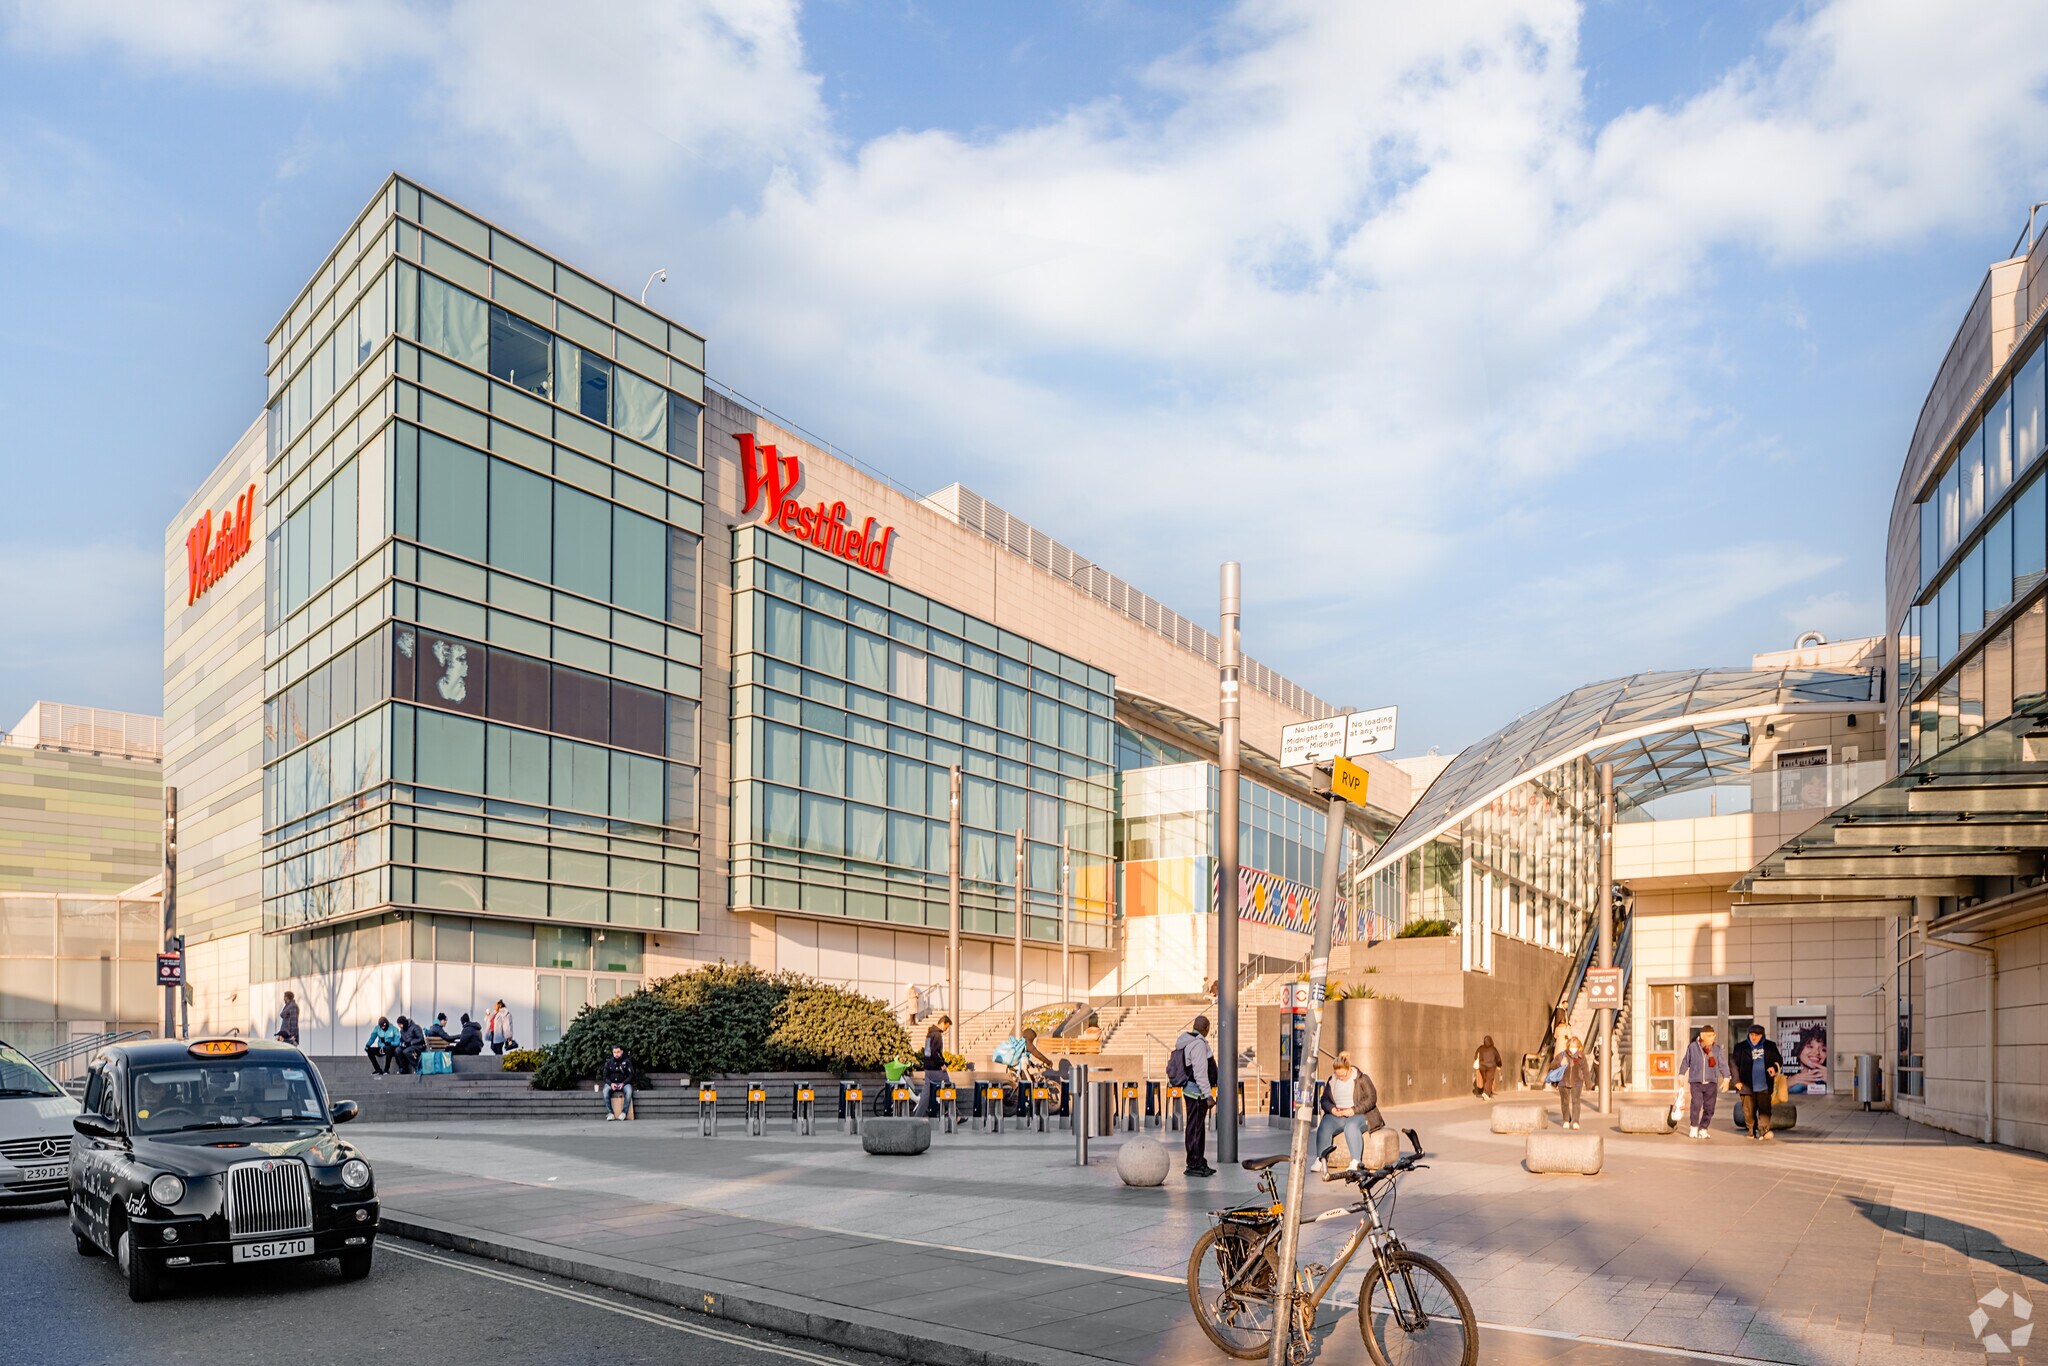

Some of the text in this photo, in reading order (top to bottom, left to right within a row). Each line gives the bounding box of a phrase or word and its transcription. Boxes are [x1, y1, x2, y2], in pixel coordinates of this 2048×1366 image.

[732, 433, 895, 574] Westfield
[185, 483, 256, 606] Westfield
[1365, 715, 1393, 726] loading
[1307, 722, 1334, 732] loading
[1360, 728, 1374, 736] any
[1287, 734, 1318, 745] Midnight
[1310, 738, 1342, 749] Midnight
[1342, 771, 1361, 790] RVP
[203, 1042, 239, 1052] TAXI
[242, 1240, 306, 1259] LS61 ZTO
